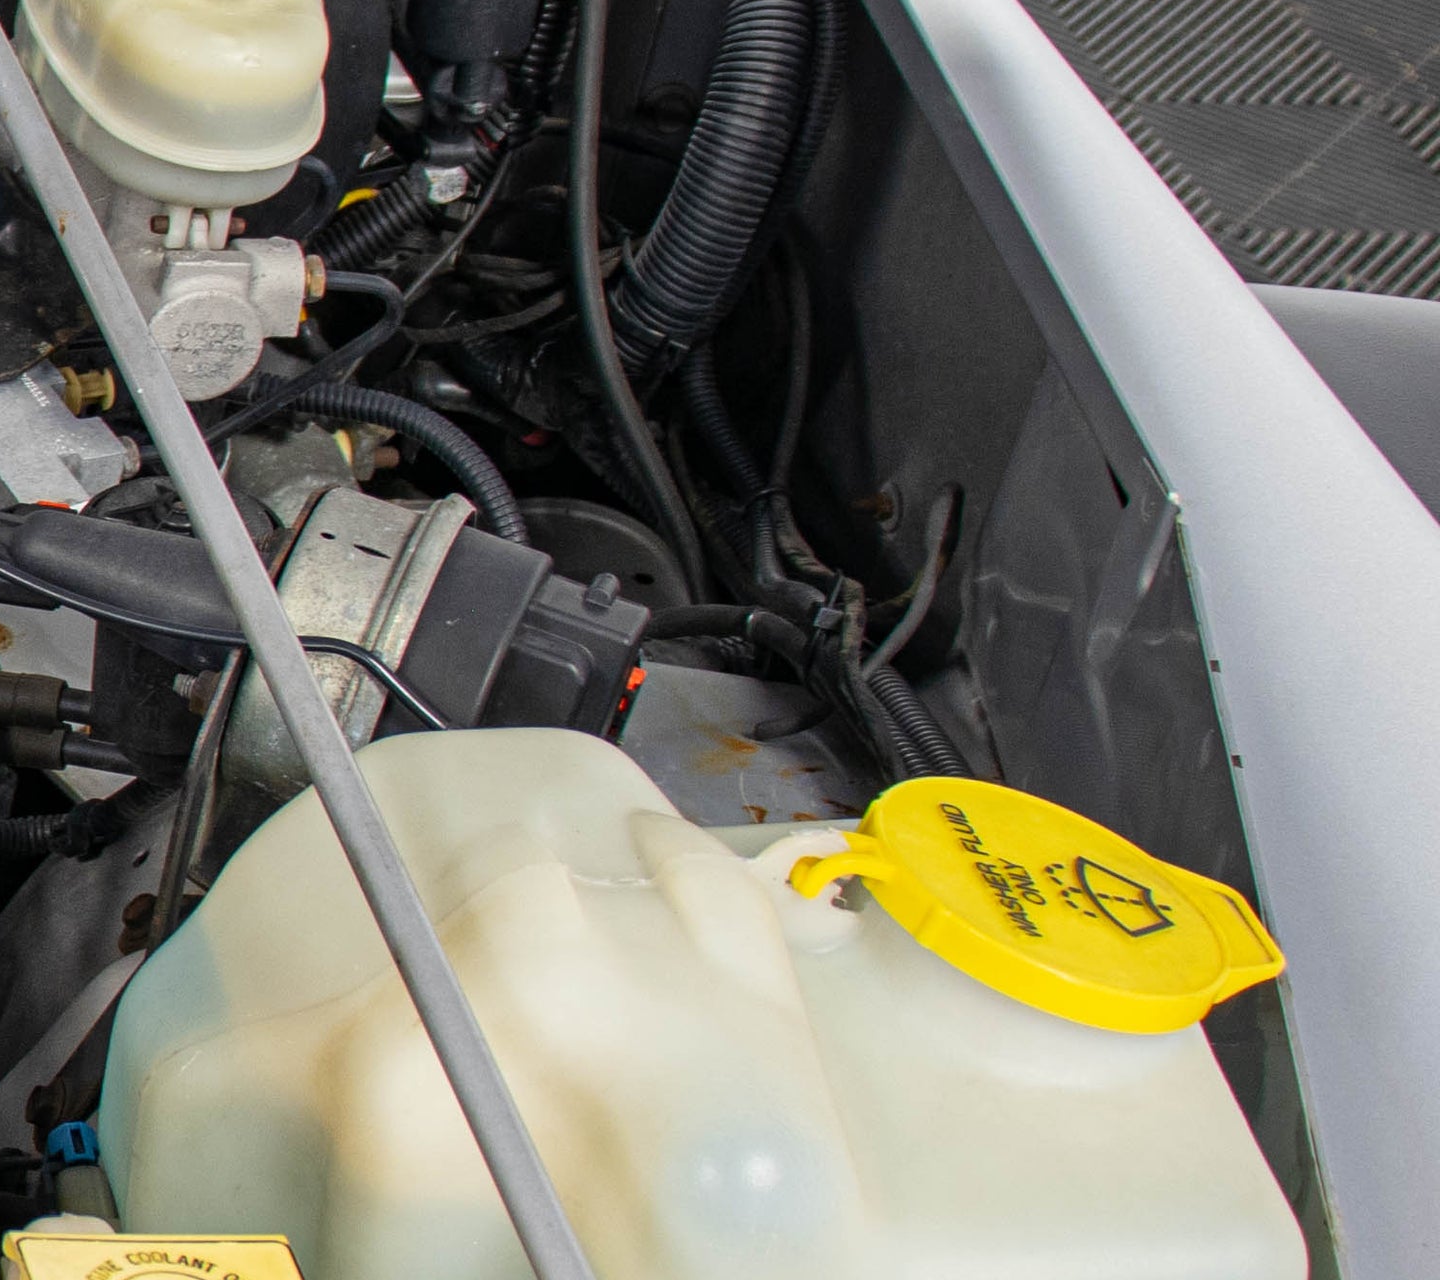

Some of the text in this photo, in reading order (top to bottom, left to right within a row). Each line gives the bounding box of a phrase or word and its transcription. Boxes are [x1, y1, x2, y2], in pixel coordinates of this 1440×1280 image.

[940, 803, 1043, 937] WASHER FLUID
[998, 858, 1046, 905] ONLY
[126, 1251, 216, 1273] COOLANT
